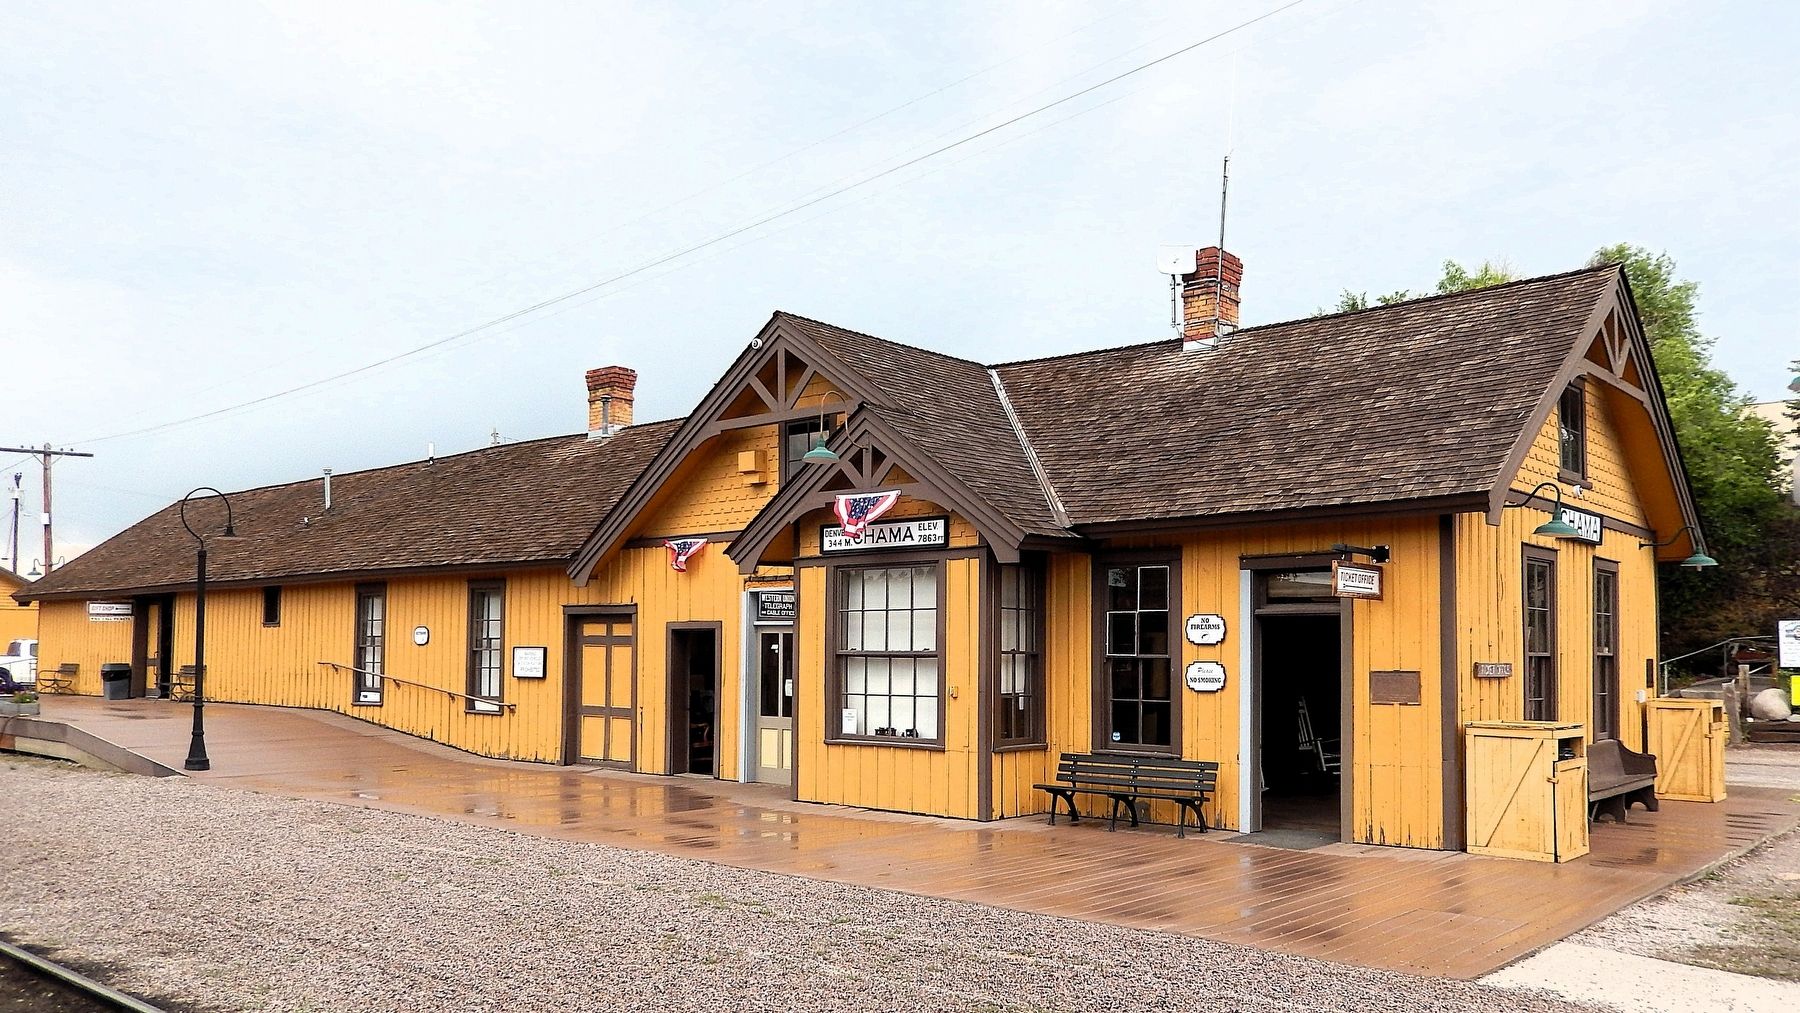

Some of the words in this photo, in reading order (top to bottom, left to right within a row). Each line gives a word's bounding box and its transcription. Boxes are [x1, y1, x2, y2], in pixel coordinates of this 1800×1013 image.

[824, 529, 845, 538] DENVE
[917, 534, 937, 543] 7863
[828, 539, 842, 548] 344
[1340, 571, 1358, 583] TICKET
[1358, 574, 1375, 585] OFFICE
[761, 593, 782, 602] WESTERN
[764, 602, 793, 610] TELEGRAPH
[1198, 676, 1222, 684] SMOKING
